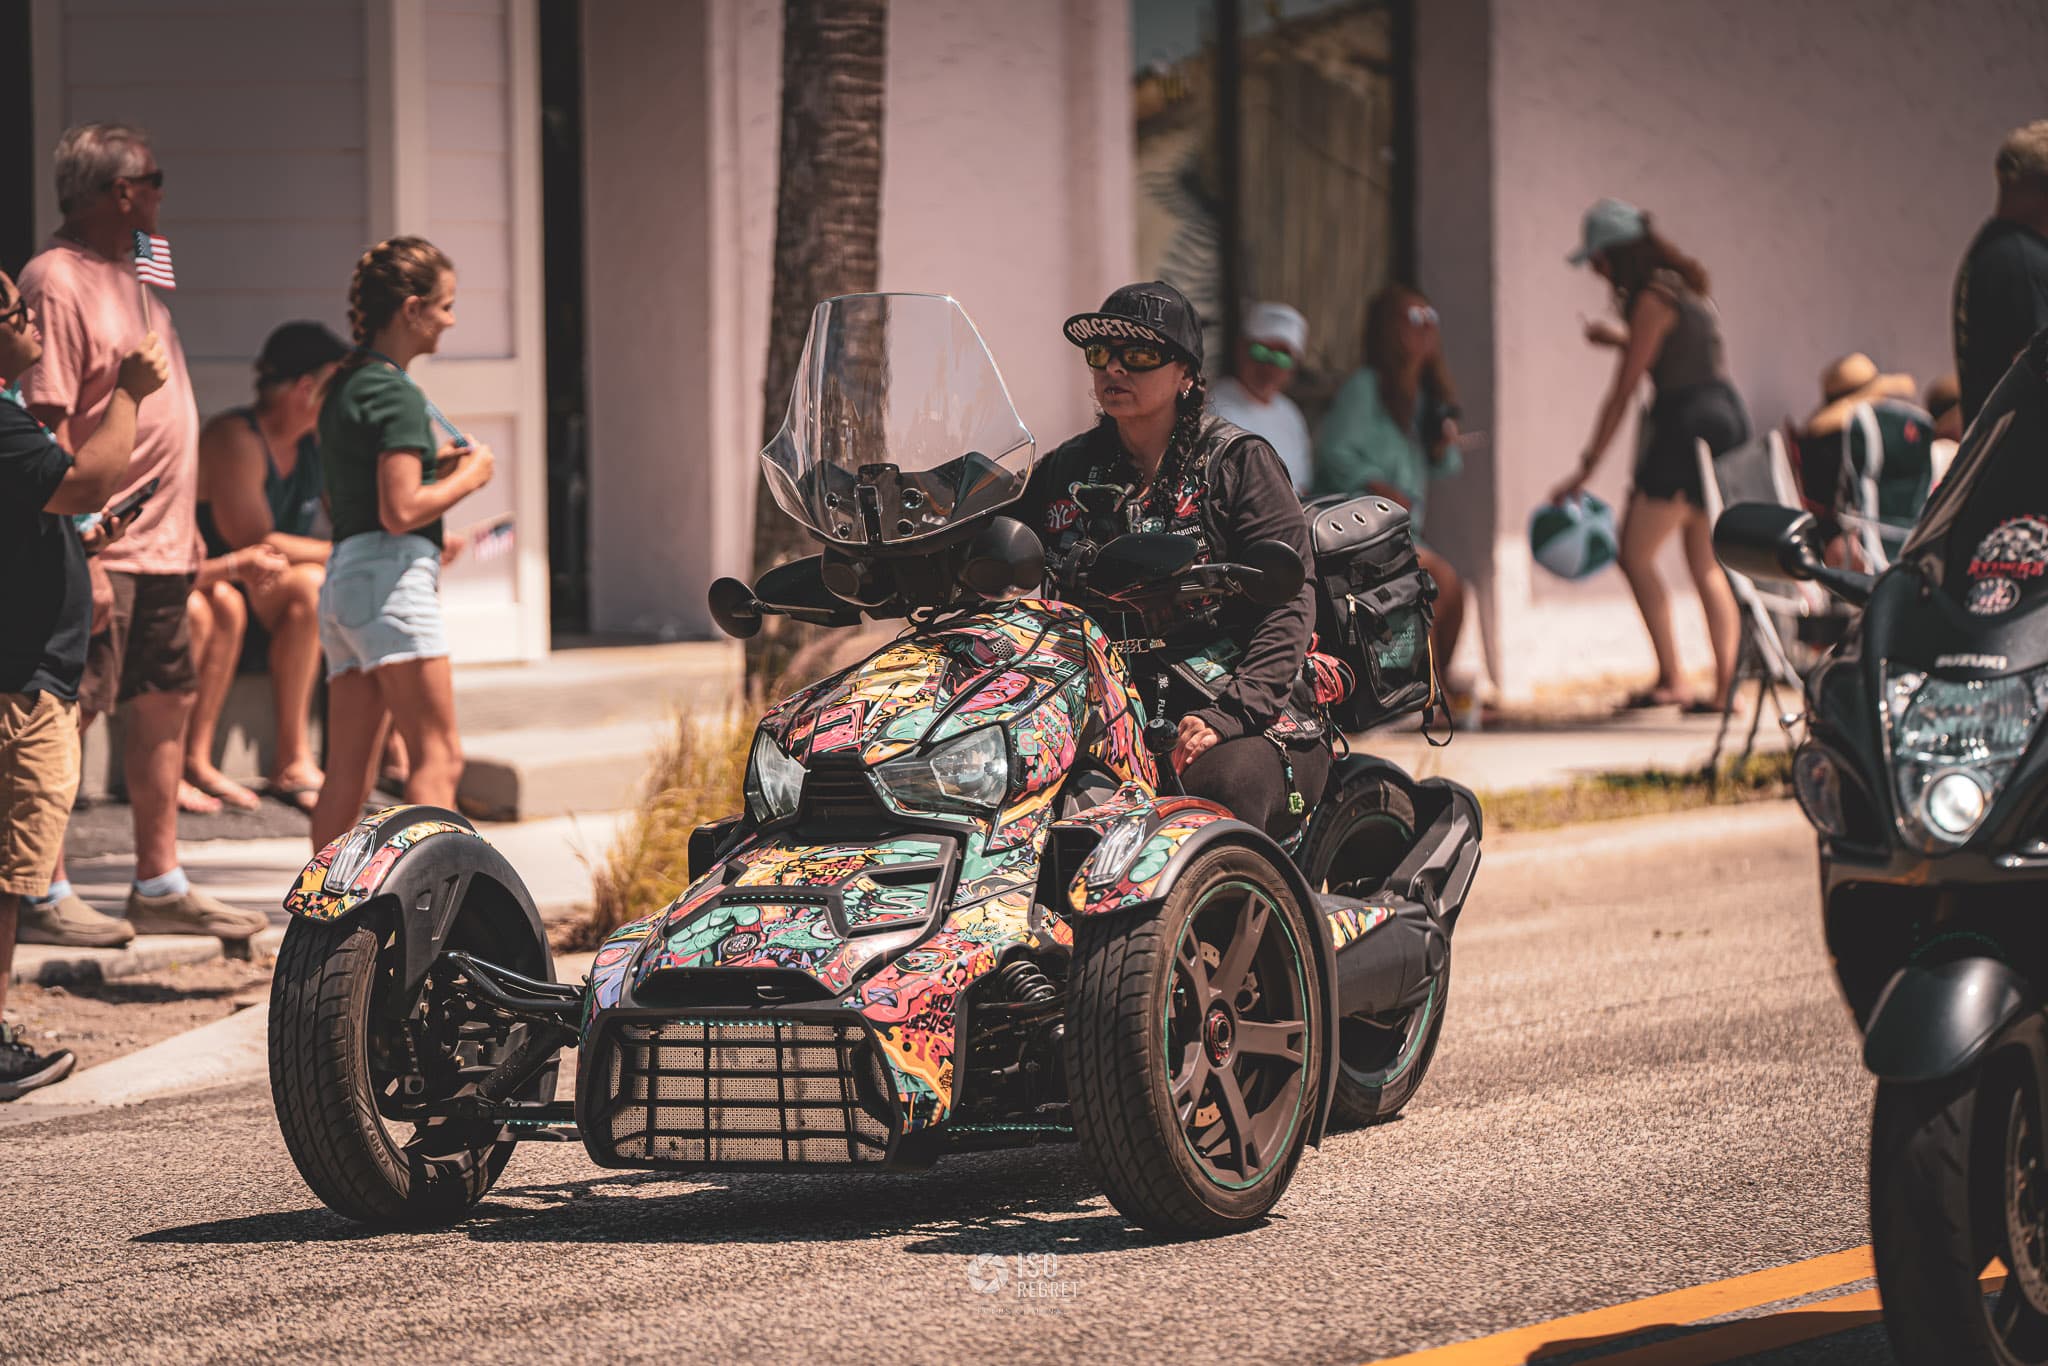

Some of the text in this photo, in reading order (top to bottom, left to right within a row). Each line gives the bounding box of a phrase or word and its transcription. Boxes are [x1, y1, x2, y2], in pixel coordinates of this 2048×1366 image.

[1134, 292, 1171, 321] NY
[1068, 317, 1166, 345] FORGETFUL
[366, 1122, 392, 1168] KENDA
